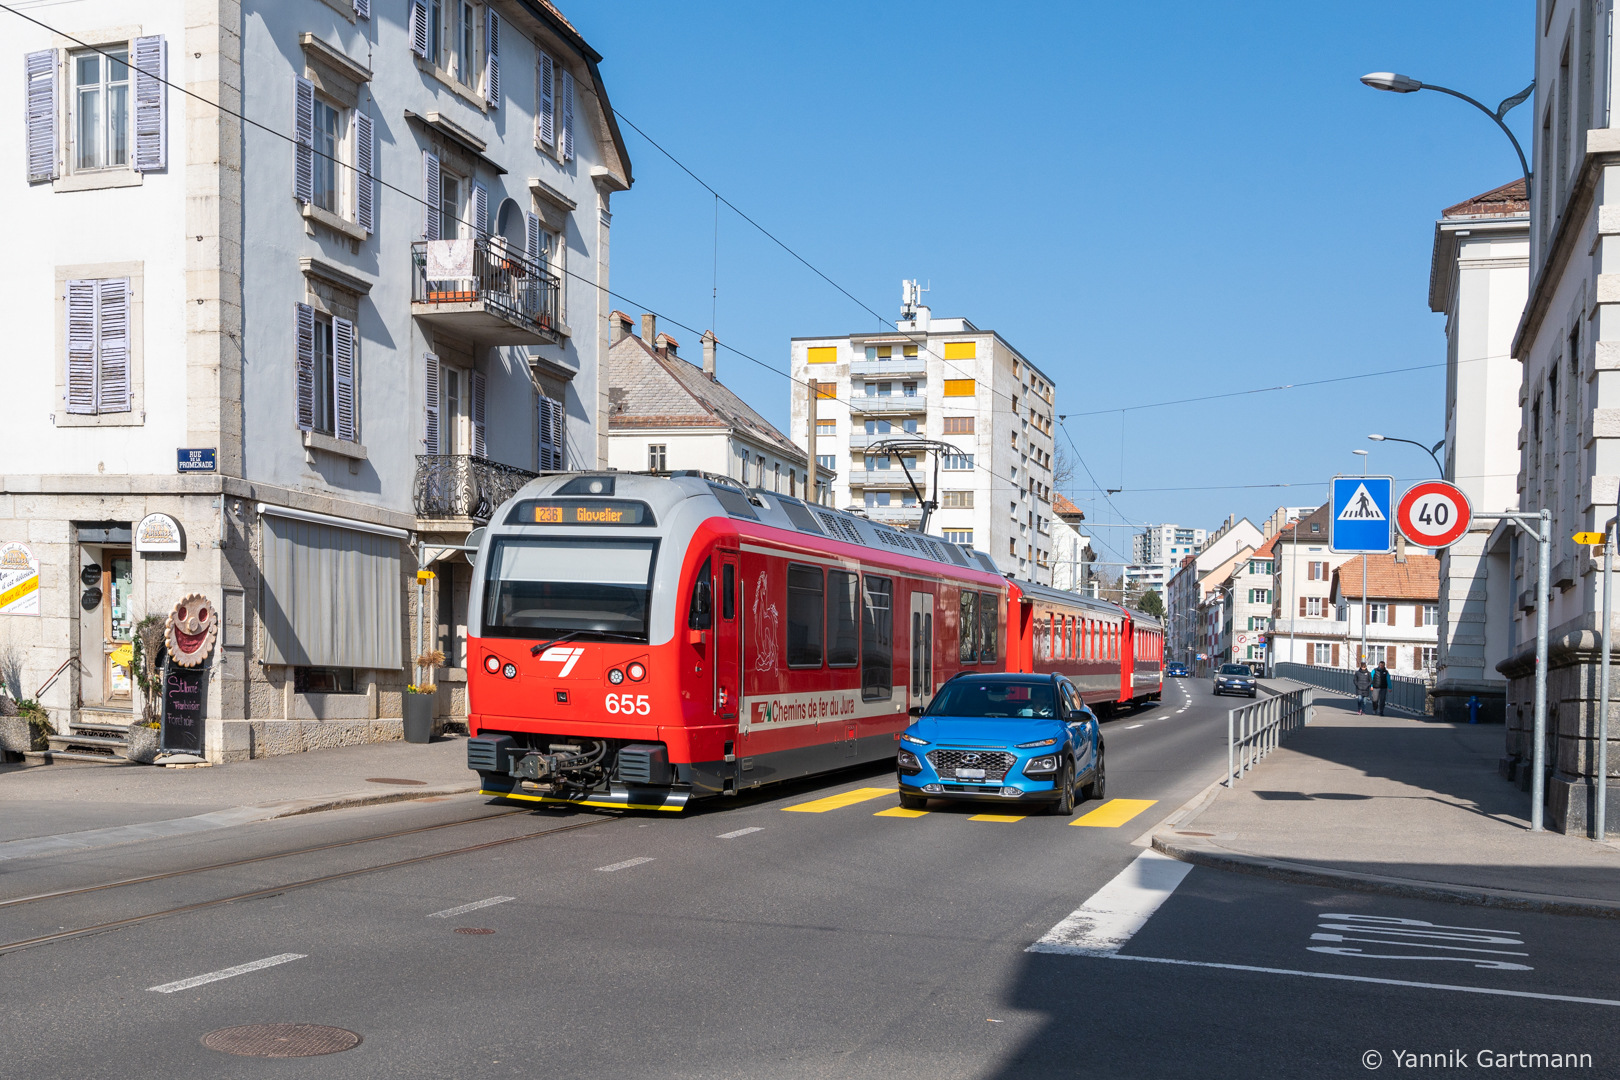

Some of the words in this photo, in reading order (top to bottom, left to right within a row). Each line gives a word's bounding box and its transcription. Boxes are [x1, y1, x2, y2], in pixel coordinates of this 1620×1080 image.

[179, 461, 214, 469] PROMENADE
[539, 507, 559, 522] 236
[577, 507, 623, 522] Glovelier
[1418, 503, 1448, 525] 40
[605, 693, 651, 715] 655
[771, 699, 806, 723] Chemins
[808, 697, 817, 719] de
[818, 697, 828, 717] fer
[829, 696, 839, 716] du
[840, 695, 855, 715] Jura
